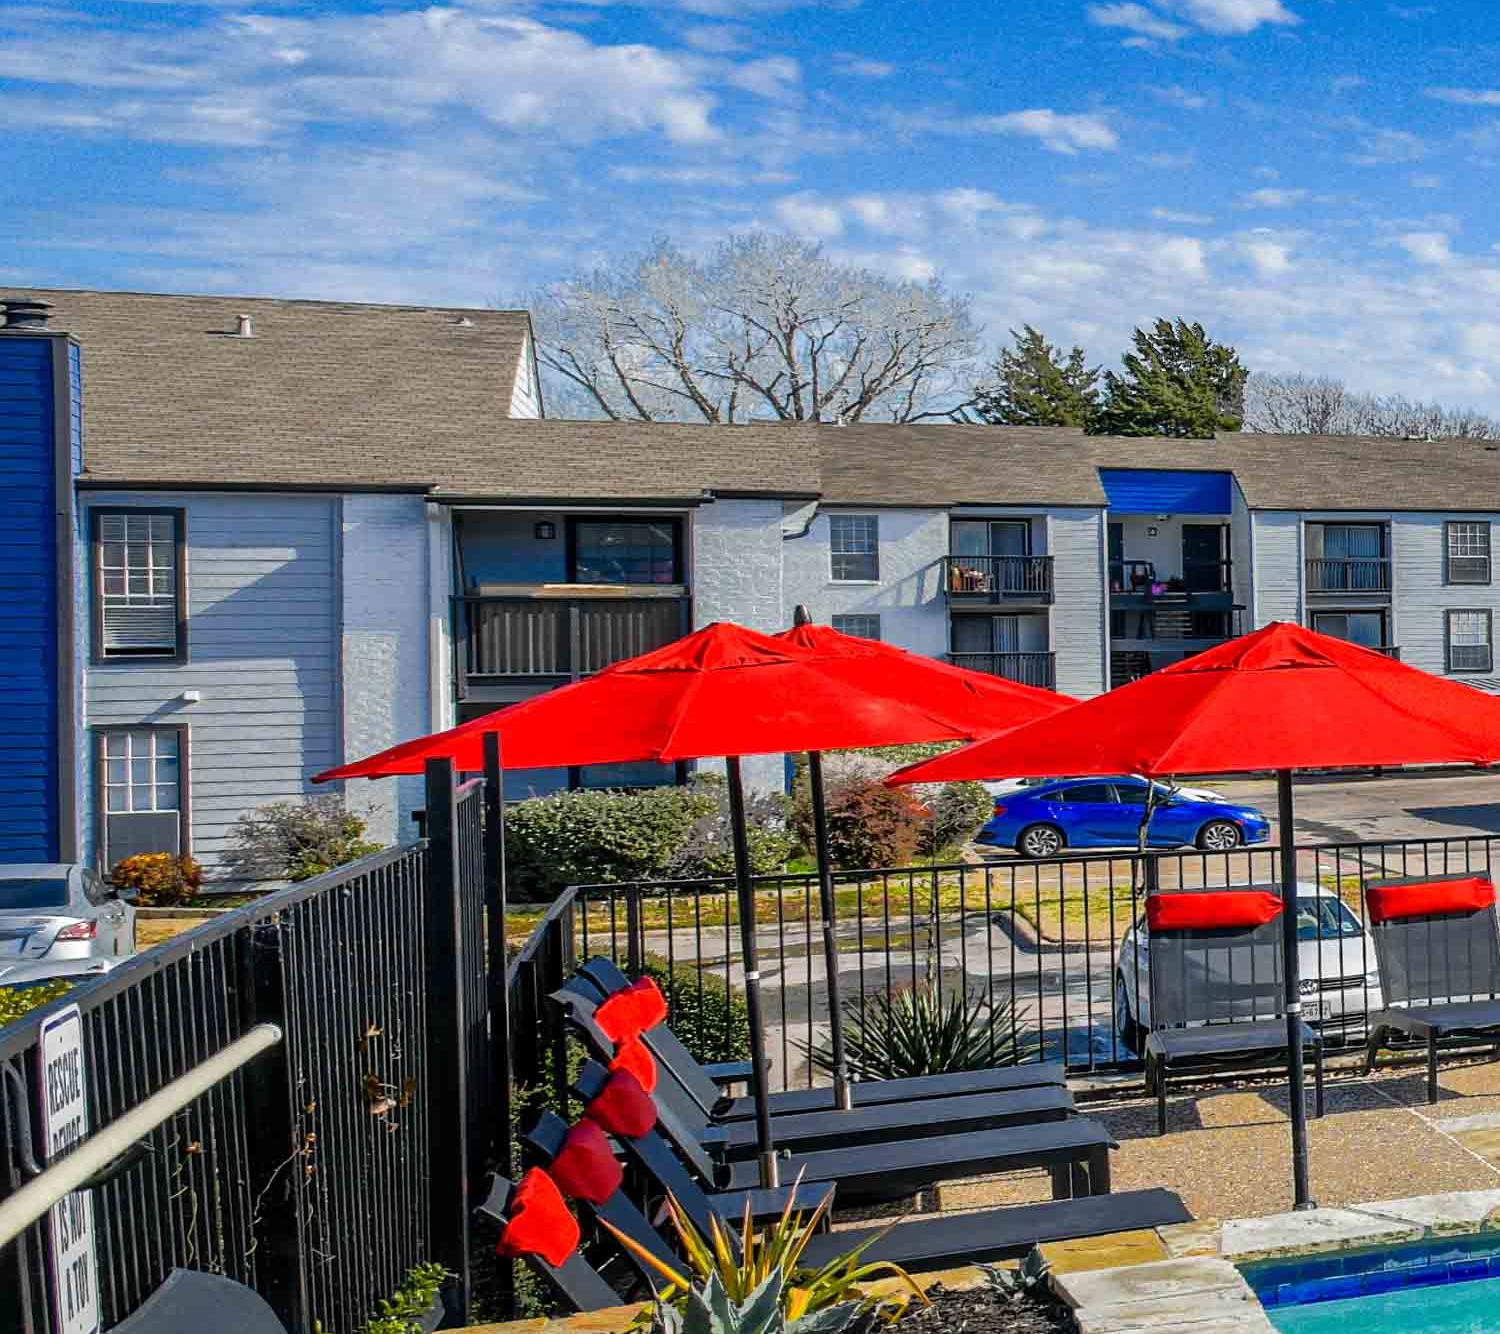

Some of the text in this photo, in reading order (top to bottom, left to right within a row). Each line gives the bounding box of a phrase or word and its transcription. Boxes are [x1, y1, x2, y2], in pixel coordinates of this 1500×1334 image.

[48, 1048, 81, 1116] RESCUE
[58, 1199, 69, 1254] IS
[67, 1250, 88, 1321] A TOY
